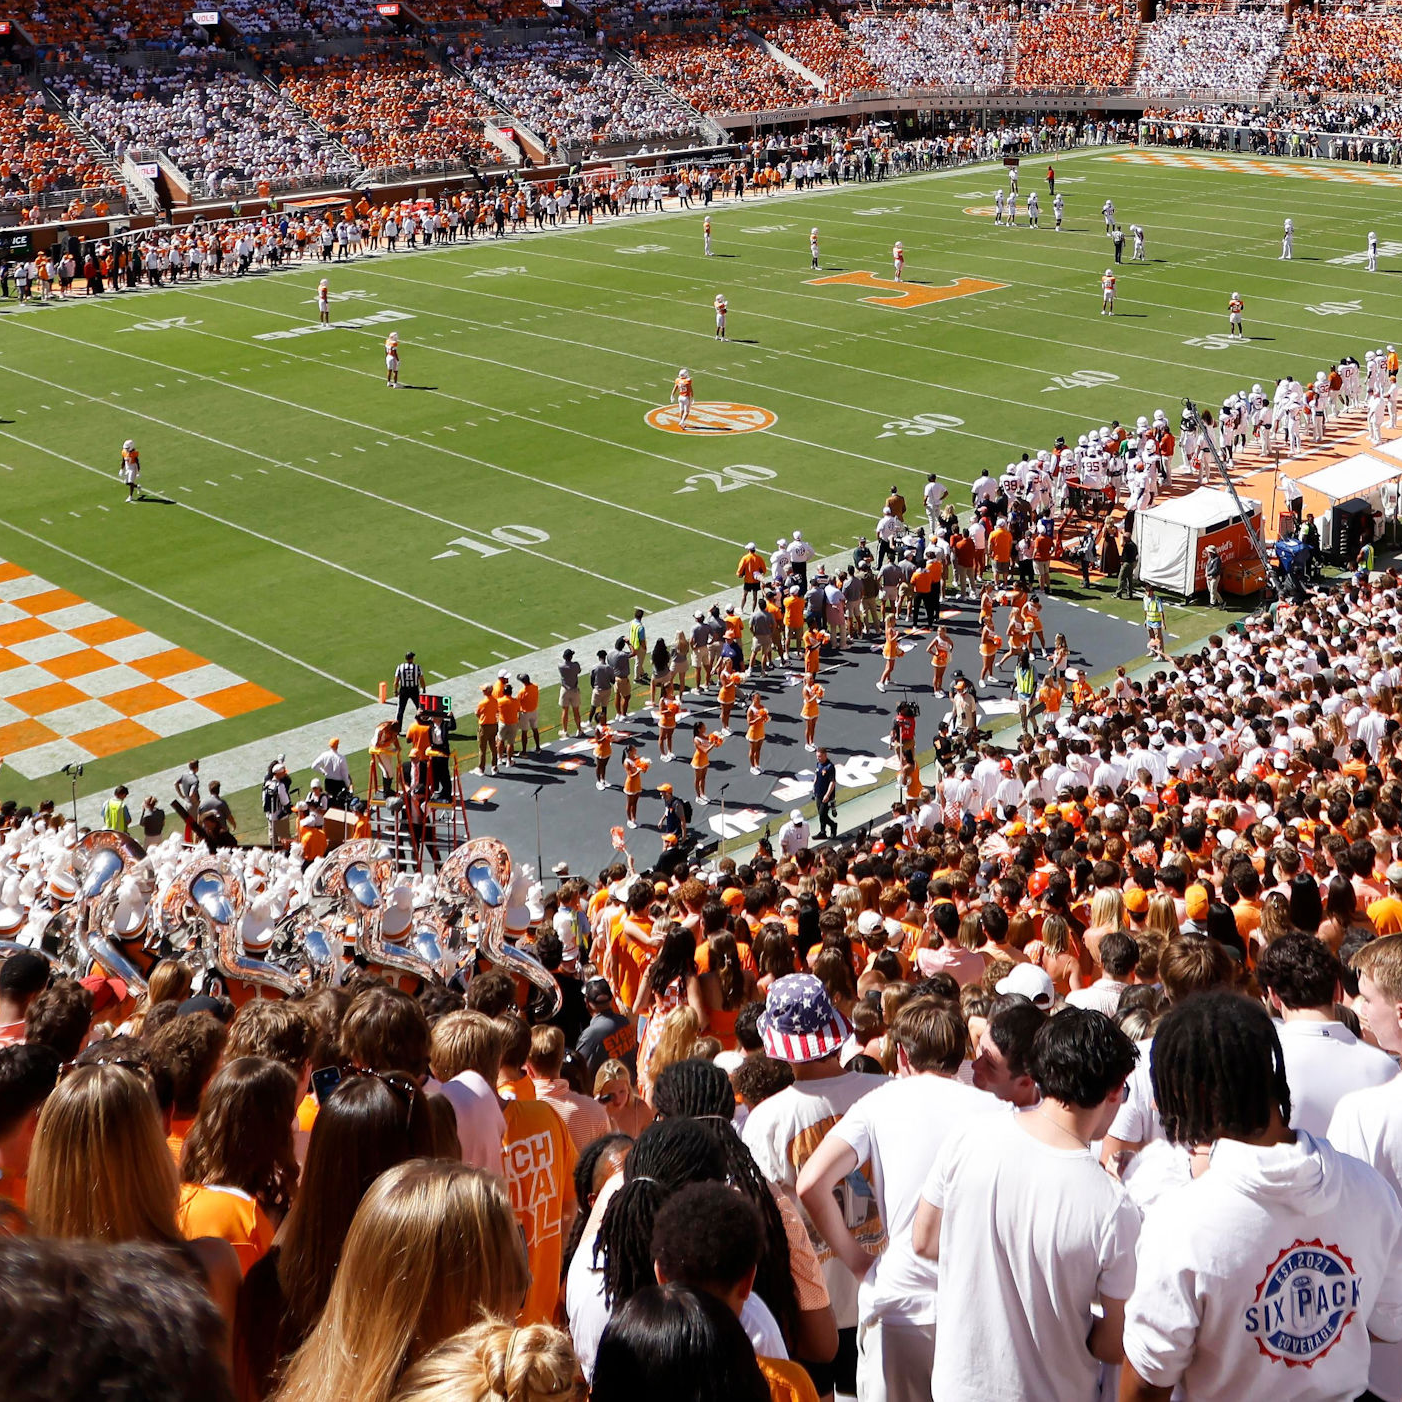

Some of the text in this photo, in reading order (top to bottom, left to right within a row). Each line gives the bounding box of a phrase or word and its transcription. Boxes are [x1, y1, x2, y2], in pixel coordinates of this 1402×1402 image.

[196, 14, 215, 22] VOLS
[405, 669, 413, 679] H
[419, 694, 451, 713] 41 9
[1244, 1277, 1363, 1334] SIX PACK
[1278, 1322, 1336, 1353] COVERAGE
